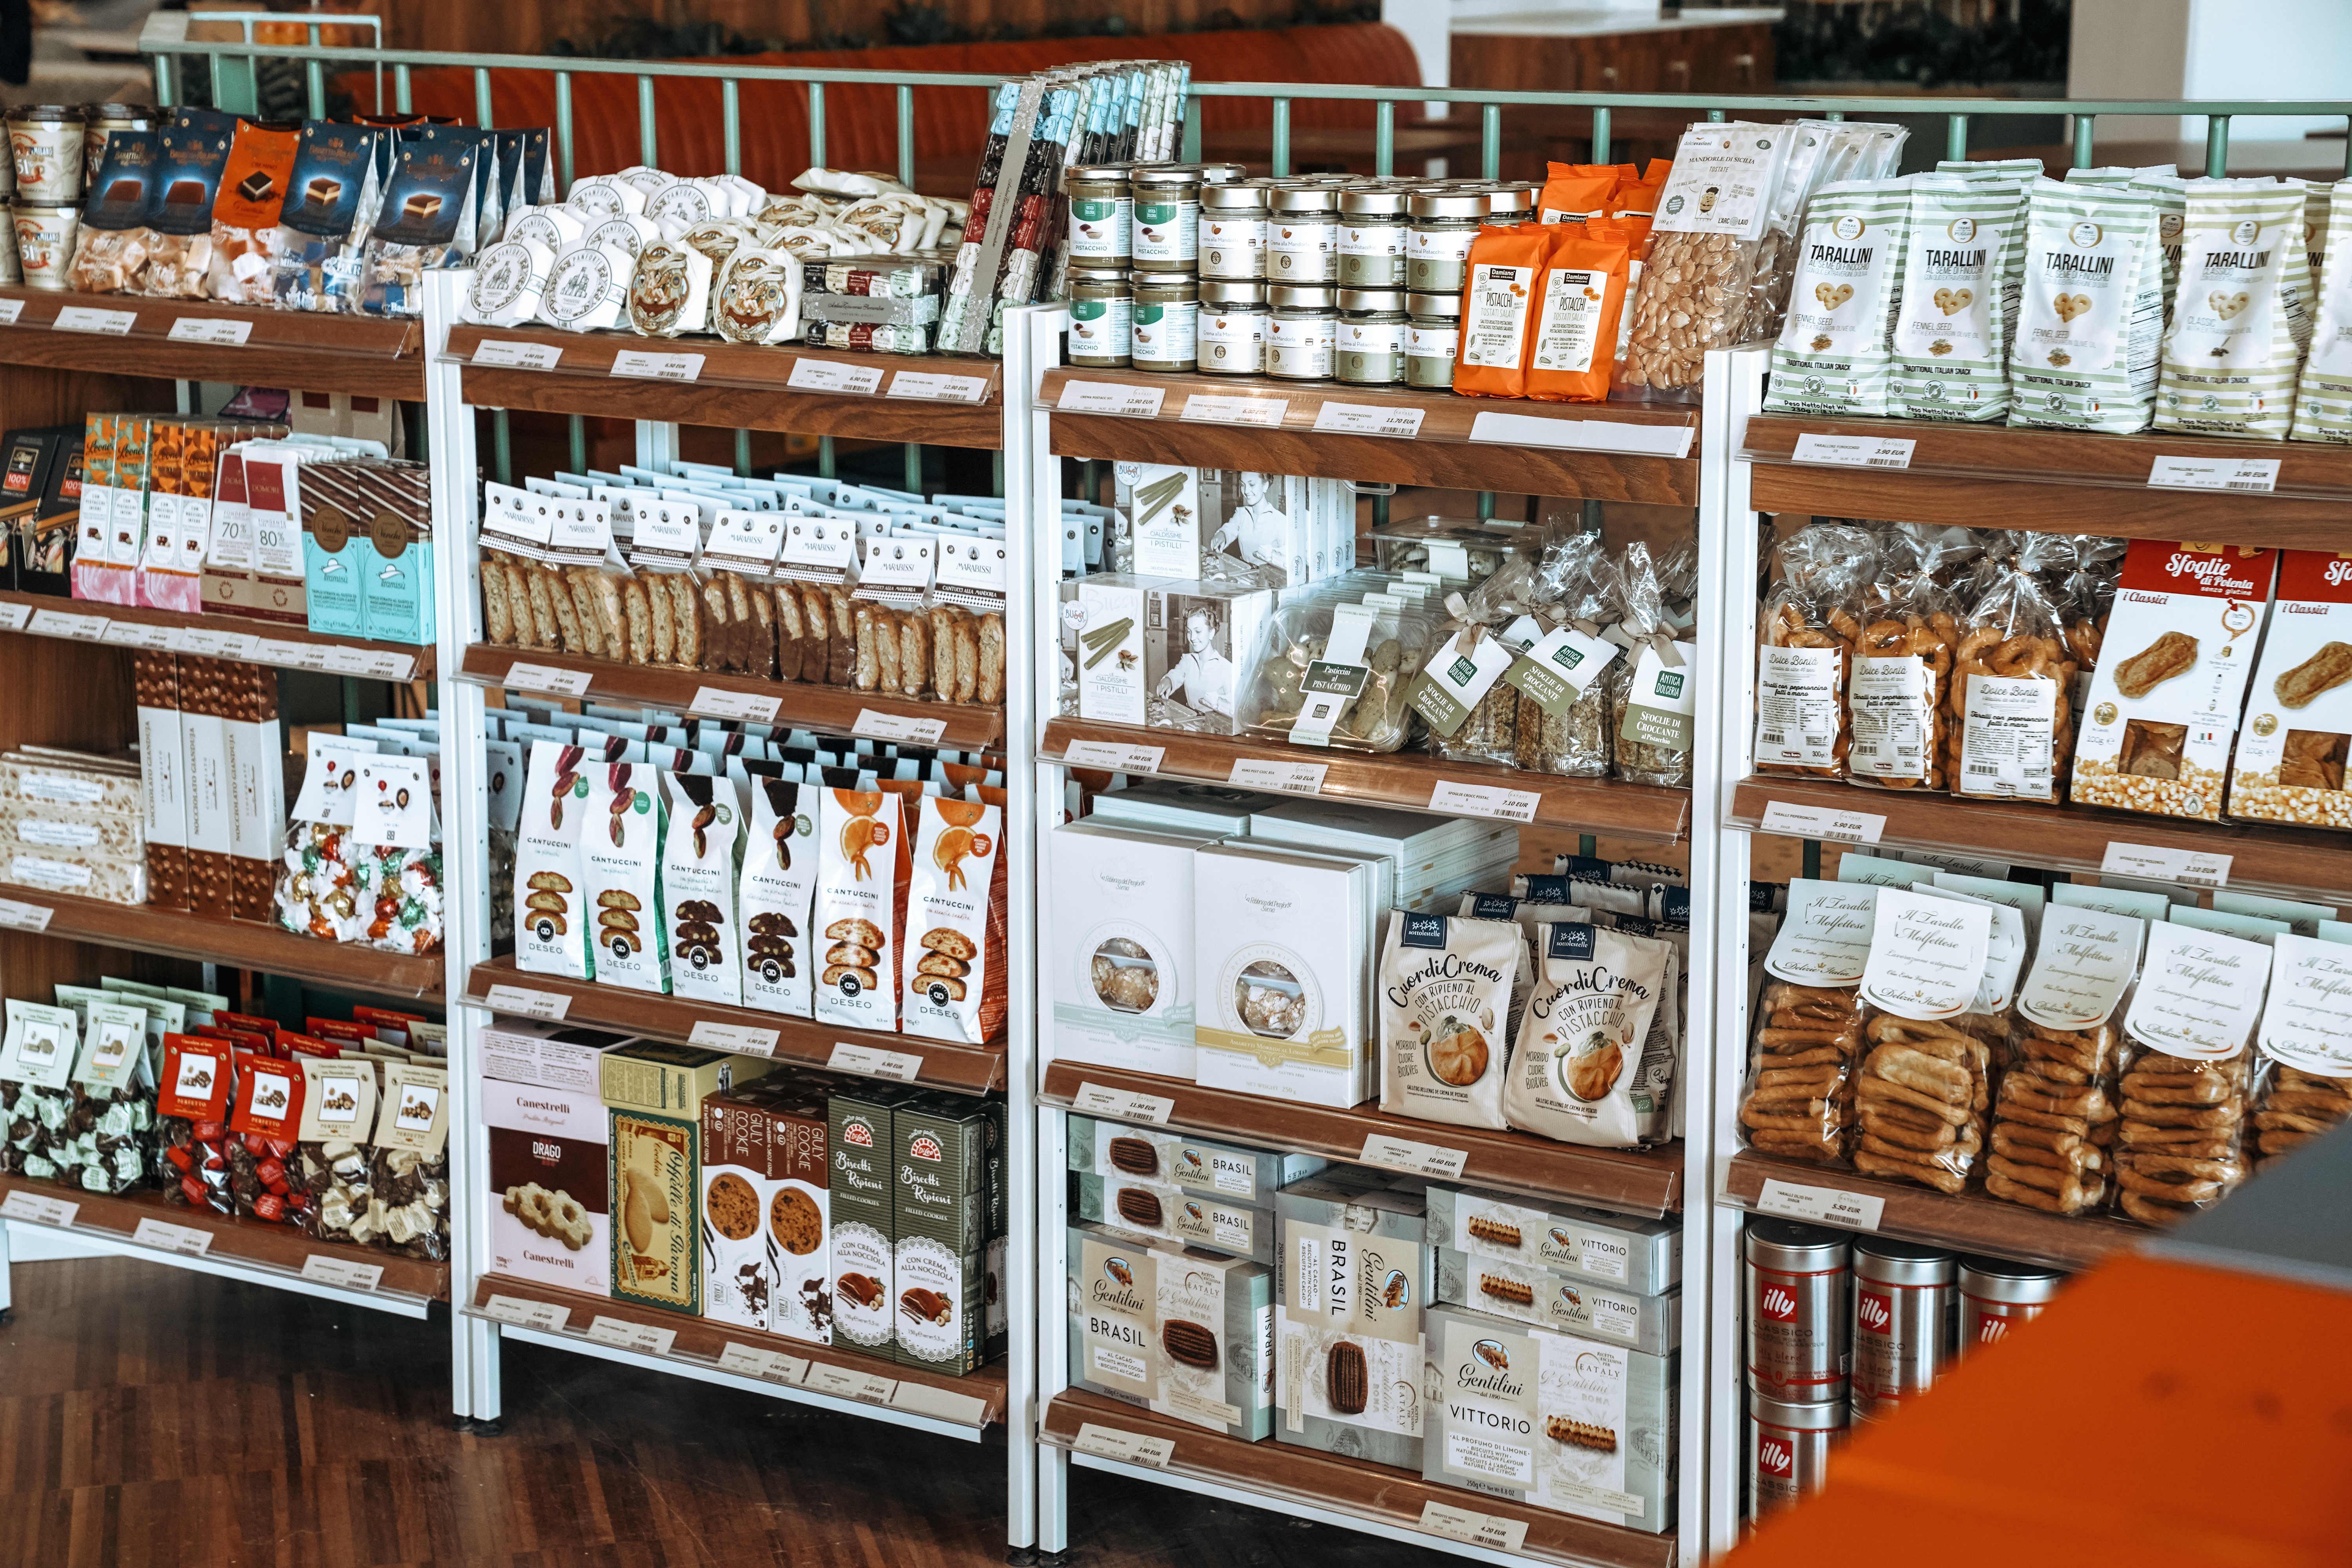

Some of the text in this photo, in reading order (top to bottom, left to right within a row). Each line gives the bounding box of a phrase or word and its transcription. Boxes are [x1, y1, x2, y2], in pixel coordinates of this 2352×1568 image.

[1810, 245, 1873, 263] TARALLINI
[1926, 249, 1986, 267] TARALLINI
[2205, 251, 2271, 269] TARALLINI
[2046, 252, 2114, 274] TARALLINI
[1486, 292, 1513, 307] PISTACCHI
[1559, 297, 1586, 311] PISTACCHI
[1481, 308, 1515, 318] TOSTATI SALATI
[1553, 312, 1587, 322] TOSTATI SALATI
[1795, 314, 1833, 325] FENNEL SEED
[7, 474, 27, 485] 100%
[503, 510, 535, 525] MARABISSI
[1150, 530, 1182, 539] CIALDISSIME
[802, 541, 836, 552] MARABISSI
[1155, 541, 1182, 549] PISTILLI
[881, 563, 914, 572] MARABISSI
[956, 562, 991, 574] MARABISSI
[2165, 553, 2231, 577] Sfoglie
[2200, 575, 2254, 590] di Polenta
[2129, 592, 2169, 605] Classici
[2290, 604, 2330, 615] Classici
[1769, 654, 1818, 666] Dolce Bontà
[1324, 666, 1351, 675] Pasticcini
[1312, 680, 1351, 692] PISTACCHIO
[1523, 671, 1561, 702] CROCCANTE
[1528, 666, 1565, 693] SFOGLIE DI
[1661, 673, 1681, 686] ANTICA
[1656, 683, 1679, 698] DOLCERIA
[1640, 711, 1681, 728] SFOGLIE DI
[1637, 722, 1680, 739] CROCCANTE
[1647, 734, 1670, 744] Pistacchio
[527, 837, 572, 849] CANTUCCINI
[591, 855, 642, 867] CANTUCCINI
[752, 875, 801, 889] CANTUCCINI
[924, 897, 974, 911] CANTUCCINI
[1826, 896, 1871, 911] Tarallo
[1805, 914, 1866, 934] Molfettese
[1916, 910, 1965, 931] Tarallo
[1894, 928, 1959, 951] Molfettese
[528, 943, 563, 955] DESEO
[831, 998, 872, 1009] DESEO
[1414, 983, 1475, 1008] CON RIPIENO AL
[920, 1006, 959, 1019] DESEO
[1417, 994, 1481, 1027] PISTACCHIO
[1395, 1040, 1417, 1051] MORBIDO
[1398, 1053, 1414, 1063] CUORE
[1397, 1065, 1418, 1078] BIO&VEG
[517, 1097, 570, 1114] Canestrelli
[736, 1111, 748, 1156] COOKIE
[750, 1113, 763, 1146] GIULY
[533, 1141, 561, 1158] DRAGO
[835, 1151, 872, 1172] Biscotti
[1212, 1158, 1252, 1176] BRASIL
[1428, 1156, 1444, 1165] 10.60
[846, 1170, 883, 1190] Ripieni
[901, 1165, 940, 1187] Biscotti
[1174, 1163, 1210, 1181] Gentilini
[912, 1184, 951, 1205] Ripieni
[671, 1212, 682, 1229] di
[857, 1243, 879, 1257] CREMA
[1540, 1241, 1579, 1263] Gentilini
[1581, 1238, 1626, 1256] VITTORIO
[523, 1250, 575, 1269] Canestrelli
[853, 1251, 886, 1267] NOCCIOLA
[1332, 1240, 1347, 1316] BRASIL
[1093, 1279, 1145, 1311] Gentilini
[1188, 1281, 1220, 1297] EATALY
[1763, 1289, 1795, 1319] illy
[1860, 1297, 1889, 1328] illy
[1090, 1317, 1147, 1348] BRASIL
[1580, 1363, 1620, 1378] EATALY
[1457, 1363, 1524, 1397] Gentilini
[1450, 1405, 1531, 1435] VITTORIO
[1760, 1442, 1790, 1472] illy
